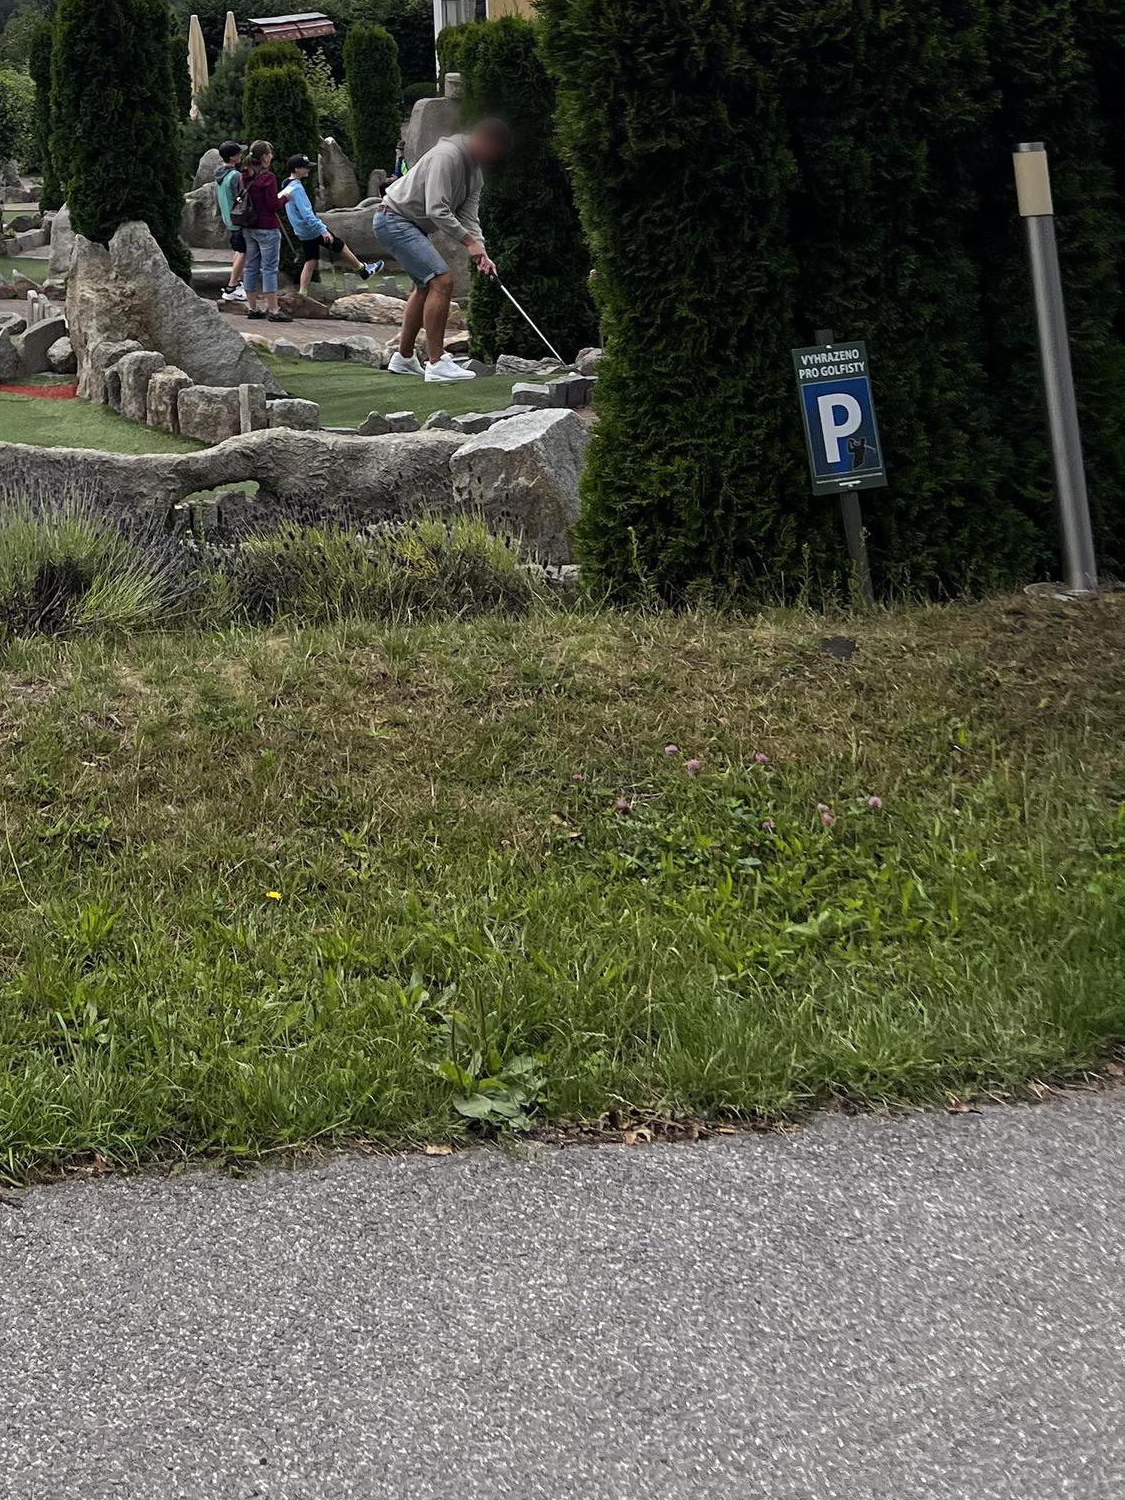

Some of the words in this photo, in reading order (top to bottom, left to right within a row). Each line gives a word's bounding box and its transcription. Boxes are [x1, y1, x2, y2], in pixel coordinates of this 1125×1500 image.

[800, 348, 860, 367] VYHRAZENO
[798, 366, 819, 380] PRO
[820, 361, 866, 377] GOLFISTY
[817, 392, 862, 464] P
